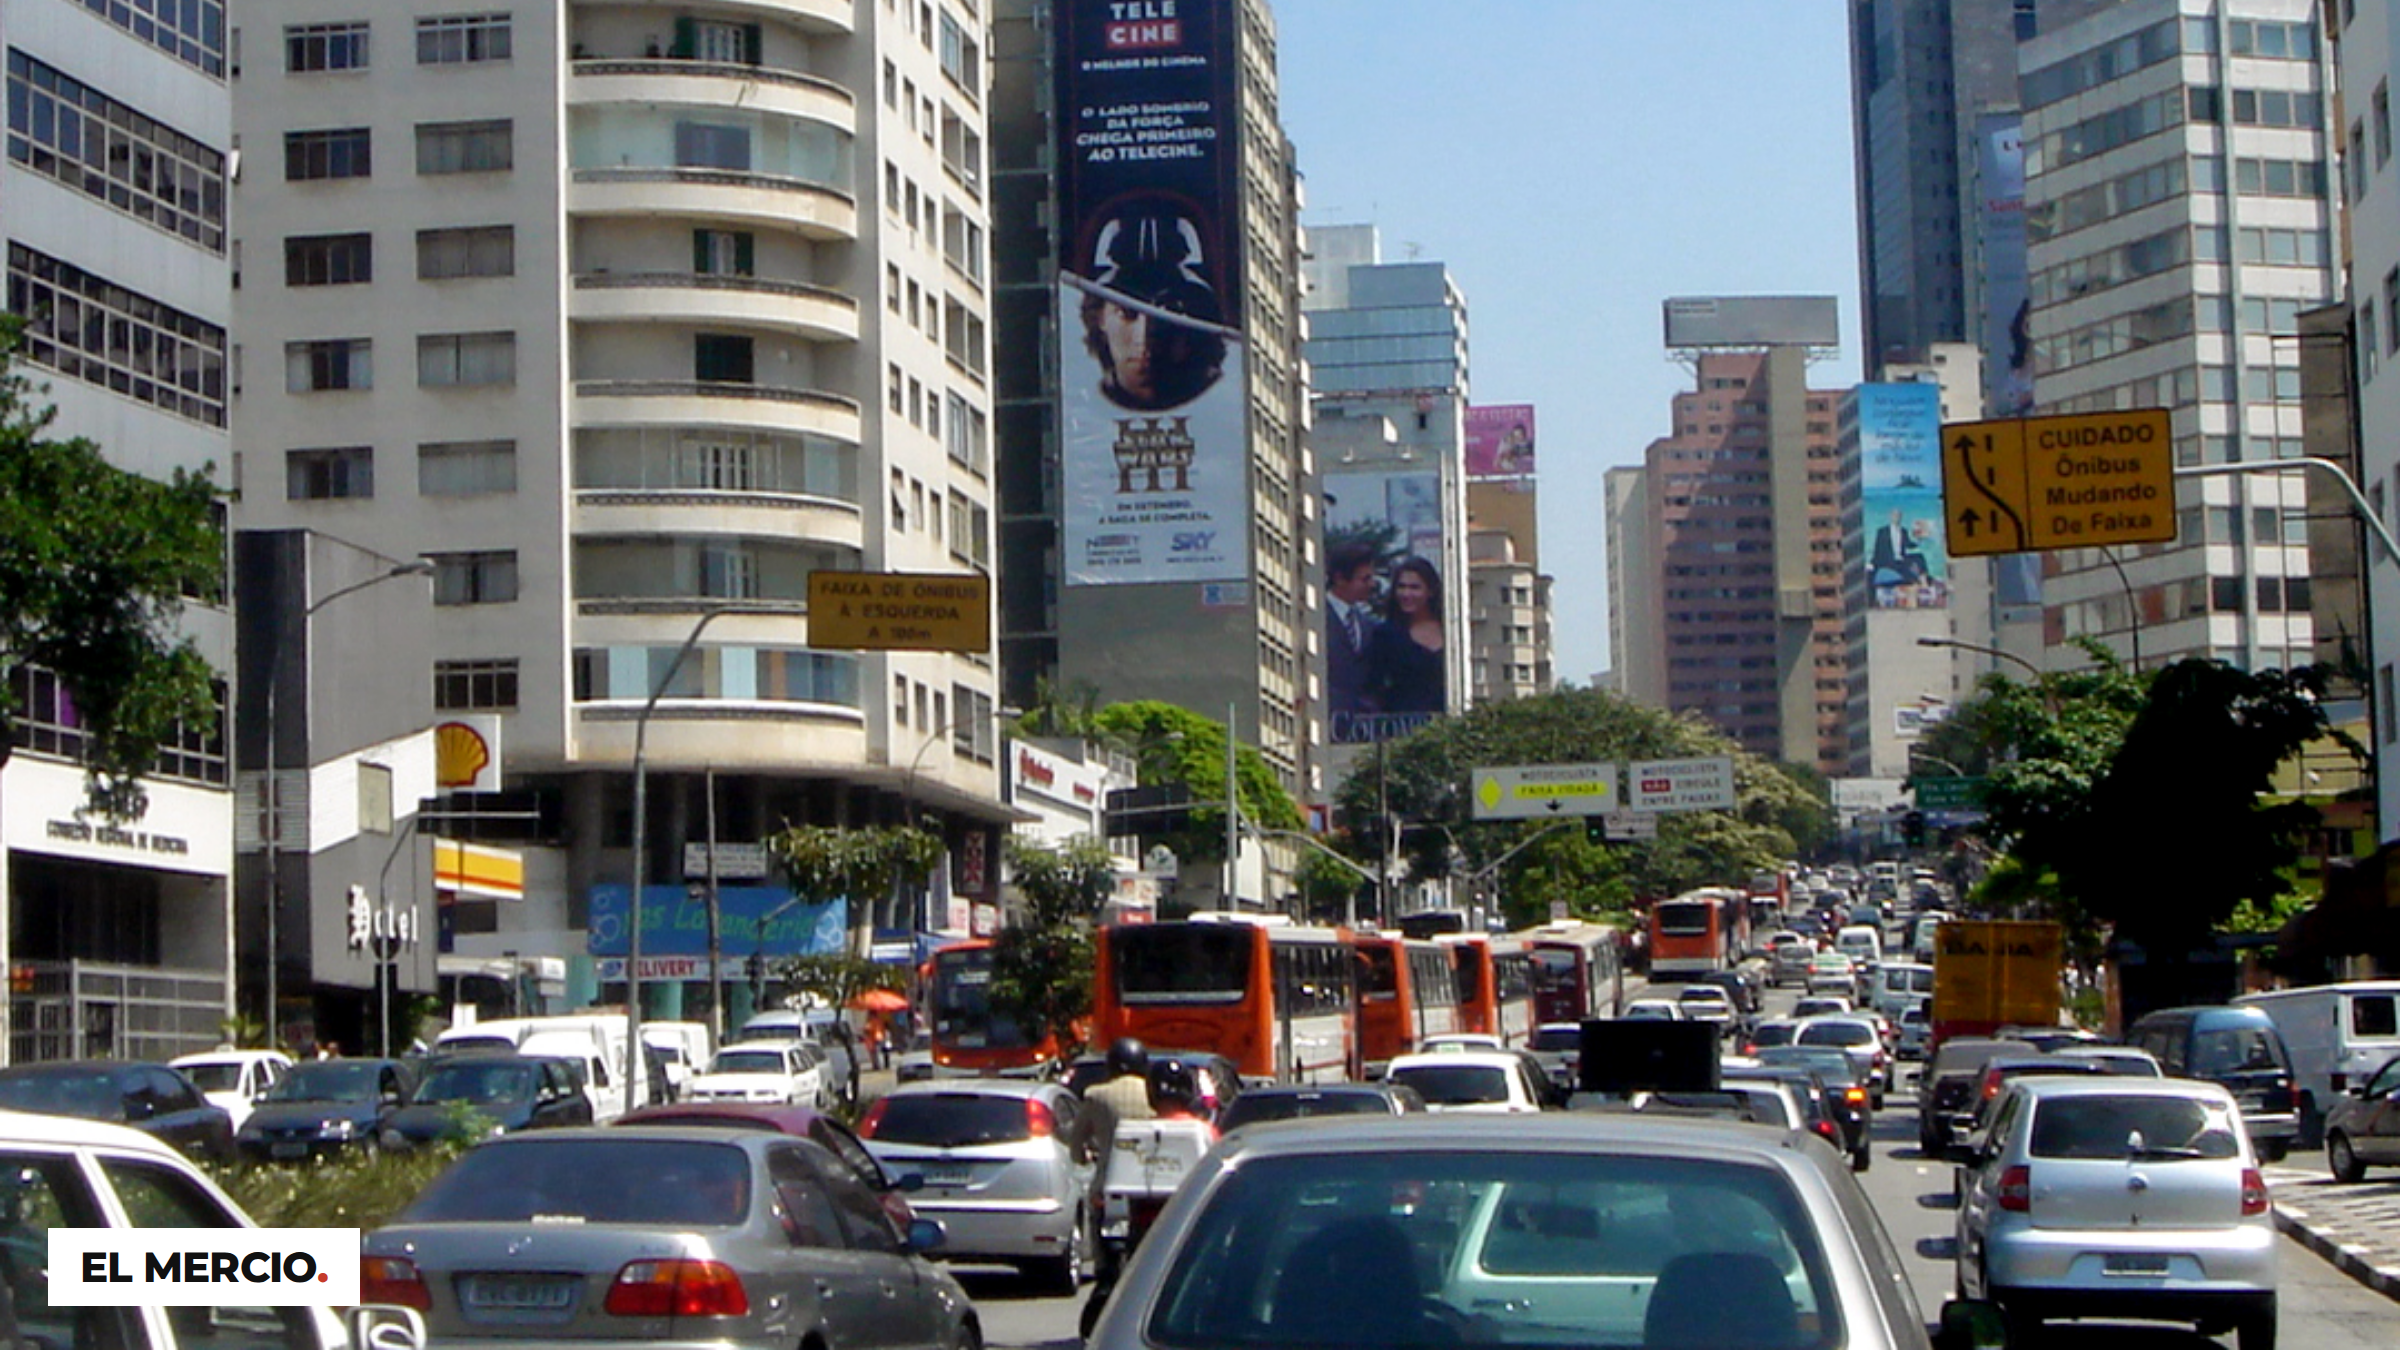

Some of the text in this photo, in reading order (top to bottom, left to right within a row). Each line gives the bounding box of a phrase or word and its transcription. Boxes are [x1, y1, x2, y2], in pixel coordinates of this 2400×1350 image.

[1109, 1, 1176, 20] TELE
[1110, 24, 1176, 43] CINE
[1093, 58, 1140, 70] MELHOR
[1143, 57, 1159, 68] DO
[1161, 55, 1207, 67] CINEMA
[1082, 101, 1210, 118] O LADO SOMBRIO
[1107, 114, 1184, 129] DA FORÇA
[1076, 127, 1216, 146] CHEGA PRIMEIRO
[1088, 144, 1204, 162] AO TELECINE.
[2038, 424, 2155, 449] CUIDADO
[2055, 453, 2141, 478] Ônibus
[2046, 483, 2157, 506] Mudando
[1109, 515, 1135, 524] SAGA
[1139, 514, 1151, 523] SE
[2053, 512, 2152, 535] De Faixa
[1171, 530, 1216, 552] SKY
[821, 582, 871, 596] FAIXA
[882, 583, 904, 597] DE
[863, 604, 960, 619] ESQUERDA
[1521, 768, 1598, 781] MOTOCICLISTA
[1641, 762, 1718, 775] MOTOCICLISTA
[1645, 780, 1668, 791] NÃO
[1641, 794, 1675, 806] ENTRE
